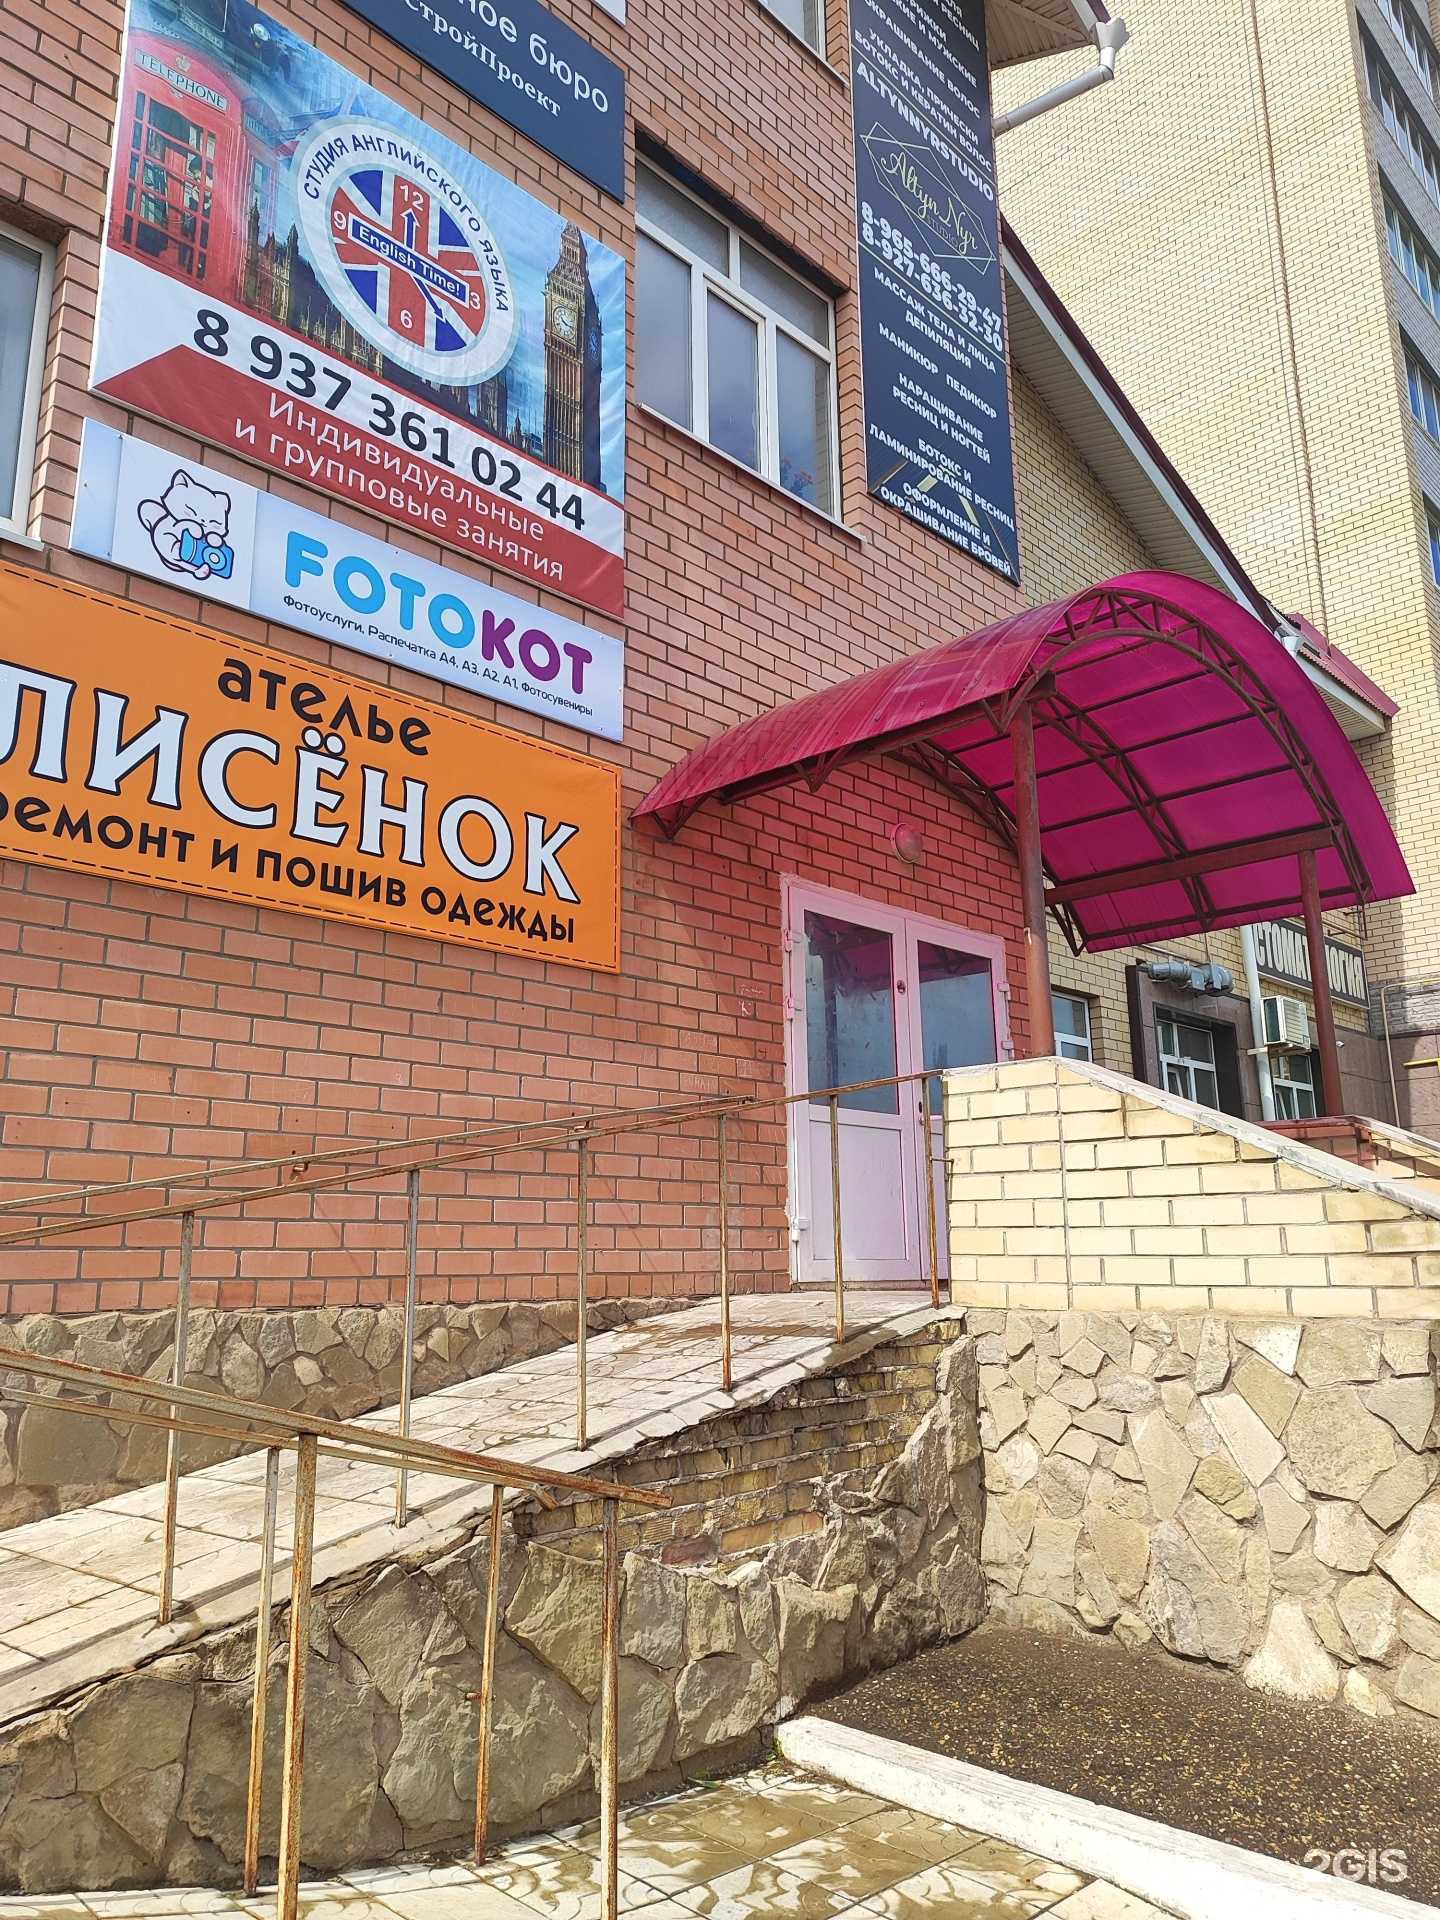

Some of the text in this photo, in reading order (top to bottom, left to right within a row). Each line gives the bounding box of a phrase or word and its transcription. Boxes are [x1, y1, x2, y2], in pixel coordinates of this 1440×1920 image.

[892, 0, 978, 89] КИЕ И МУЖСКИЕ
[905, 0, 947, 42] РИЖКИ
[940, 2, 980, 52] РЕСНИЦ
[140, 54, 225, 109] TELEPHONE
[529, 33, 608, 113] бюро
[854, 28, 993, 173] БОТОКС И КЕРАТИН ВОЛОС
[868, 27, 979, 146] УКЛАДКА, ПРИЧЕСКИ
[946, 79, 981, 119] ВОЛОС
[856, 61, 994, 201] ALTYNNYRSTUDIO
[303, 133, 509, 312] СТУДИЯ АНГЛИЙСКОГО ЯЗЫКА
[333, 210, 348, 231] 9
[399, 184, 424, 212] 12
[880, 151, 940, 219] Altyn
[358, 224, 461, 296] English Time!
[468, 291, 482, 310] 3
[861, 201, 1001, 333] 8-965-666-29-47
[862, 221, 1003, 352] 8-927-636-32-30
[399, 309, 414, 330] 6
[874, 265, 997, 375] МАССАЖ ТЕЛА И ЛИЦА
[905, 308, 972, 369] ДЕПИЛЯЦИЯ
[879, 321, 997, 420] МАНИКЮР ПЕДИКЮР
[899, 371, 984, 443] НАРАЩИВАНИЕ
[193, 307, 586, 531] 8 937 361 02 44
[892, 385, 991, 465] РЕСНИЦ И НОГТЕЙ
[918, 437, 973, 484] БОТОКС И
[234, 417, 564, 583] и групповые занятия
[268, 391, 544, 542] Индивидуальные
[869, 423, 1015, 533] ЛАМИНИРОВАНИЕ РЕСНИЦ
[879, 485, 1011, 577] ОКРАШИВАНИЕ БРОВЕЙ
[902, 481, 991, 546] ОФОРМЛЕНИЕ И
[217, 656, 432, 757] ателье
[367, 624, 437, 661] Распечатка
[521, 681, 593, 717] Фотосувениры
[0, 658, 582, 905] ЛИСЁНОК
[211, 837, 239, 876] и
[256, 846, 406, 908] пошив
[420, 884, 575, 945] одежды
[1252, 921, 1366, 1001] СТОМАТОГИЯ
